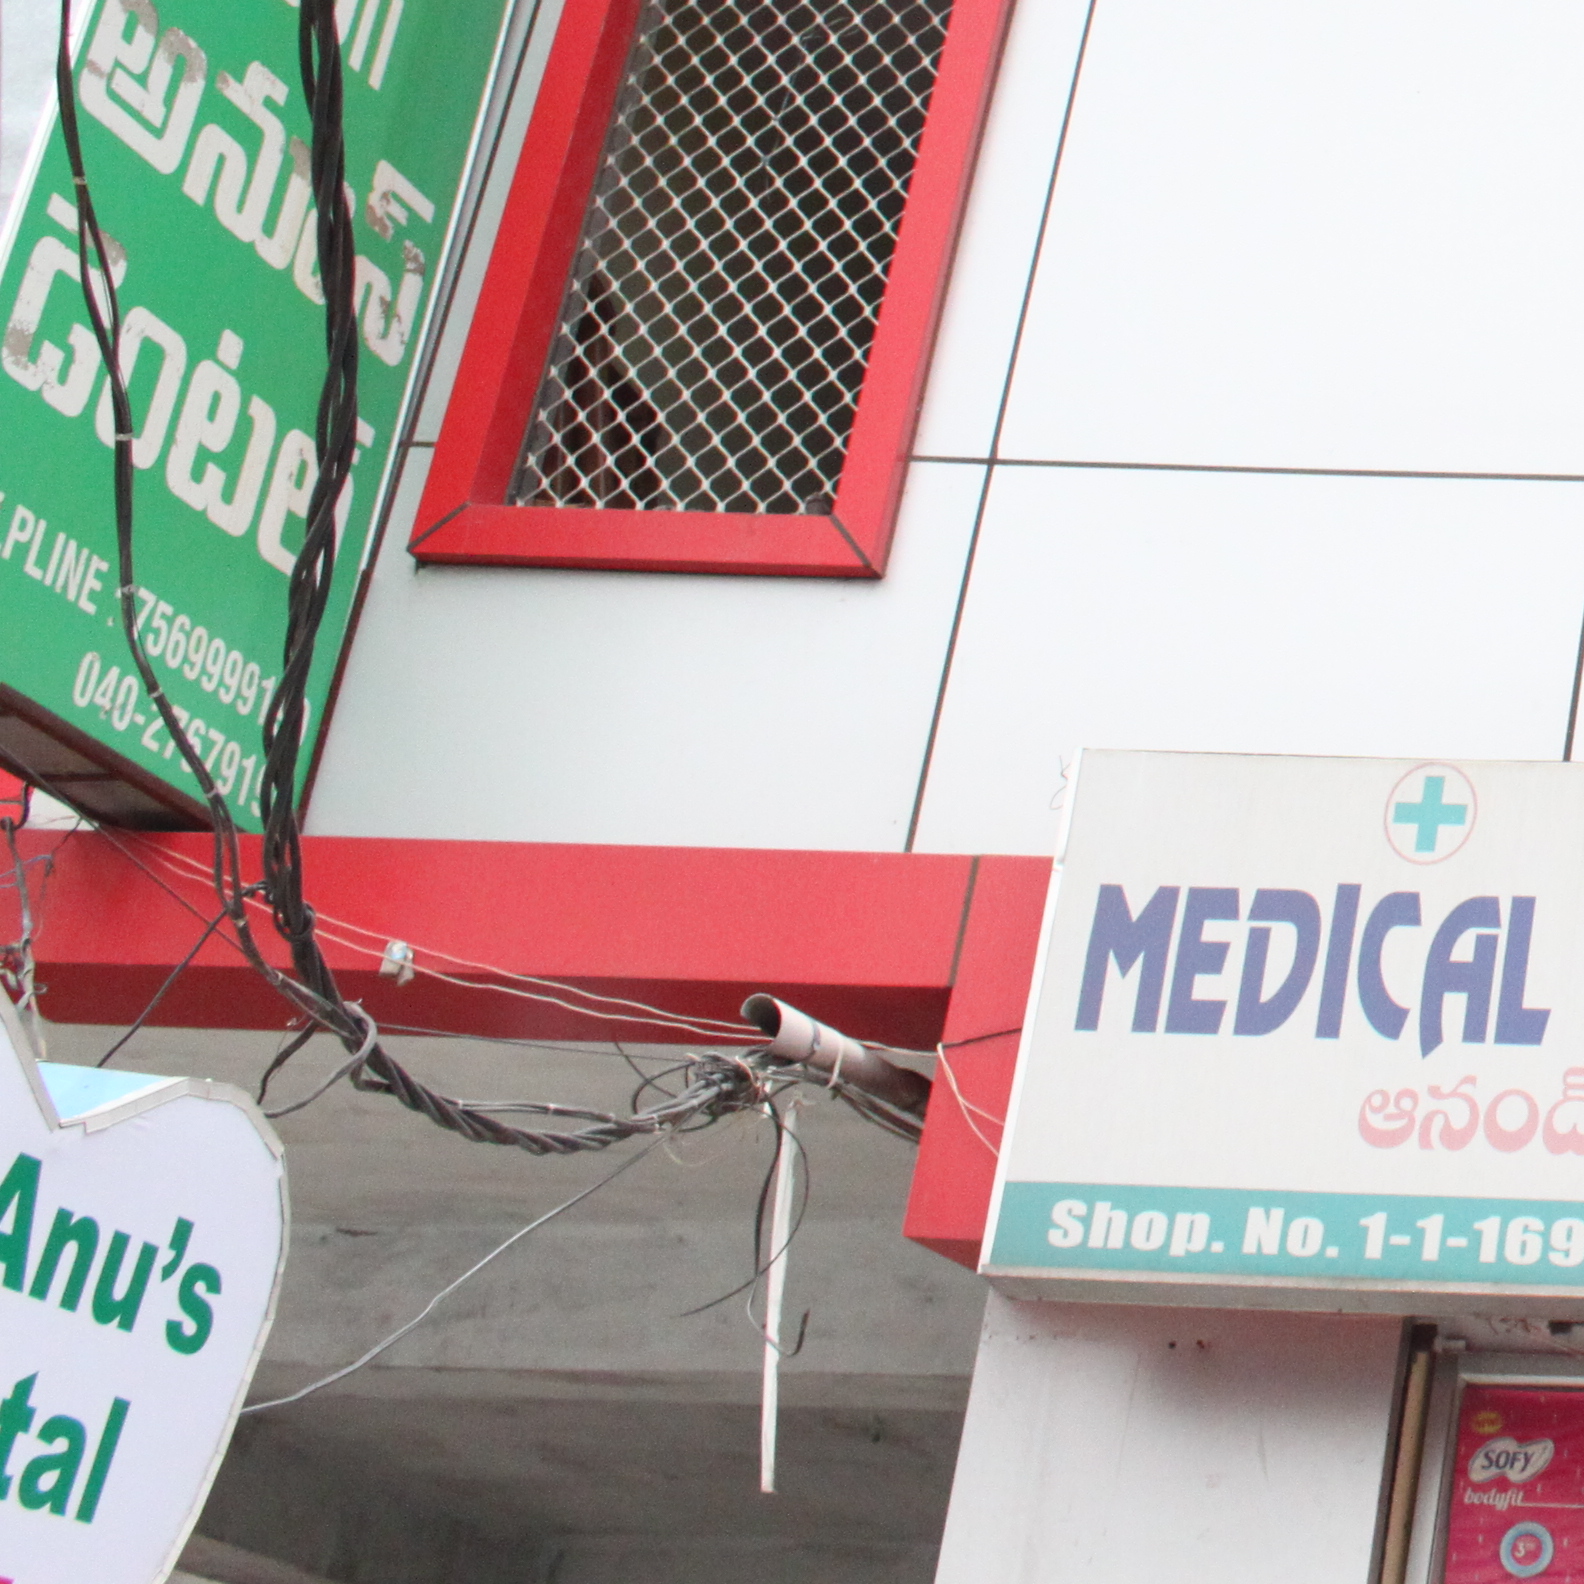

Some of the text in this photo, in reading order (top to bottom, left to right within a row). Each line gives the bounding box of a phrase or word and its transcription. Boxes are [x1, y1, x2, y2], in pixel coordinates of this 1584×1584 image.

[0, 500, 109, 616] PLINE
[1073, 883, 1552, 1060] MEDICAL
[1047, 1198, 1224, 1257] Shop.
[1242, 1206, 1340, 1258] No.
[1481, 1449, 1535, 1472] SOFY
[1464, 1487, 1525, 1511] bodyfit
